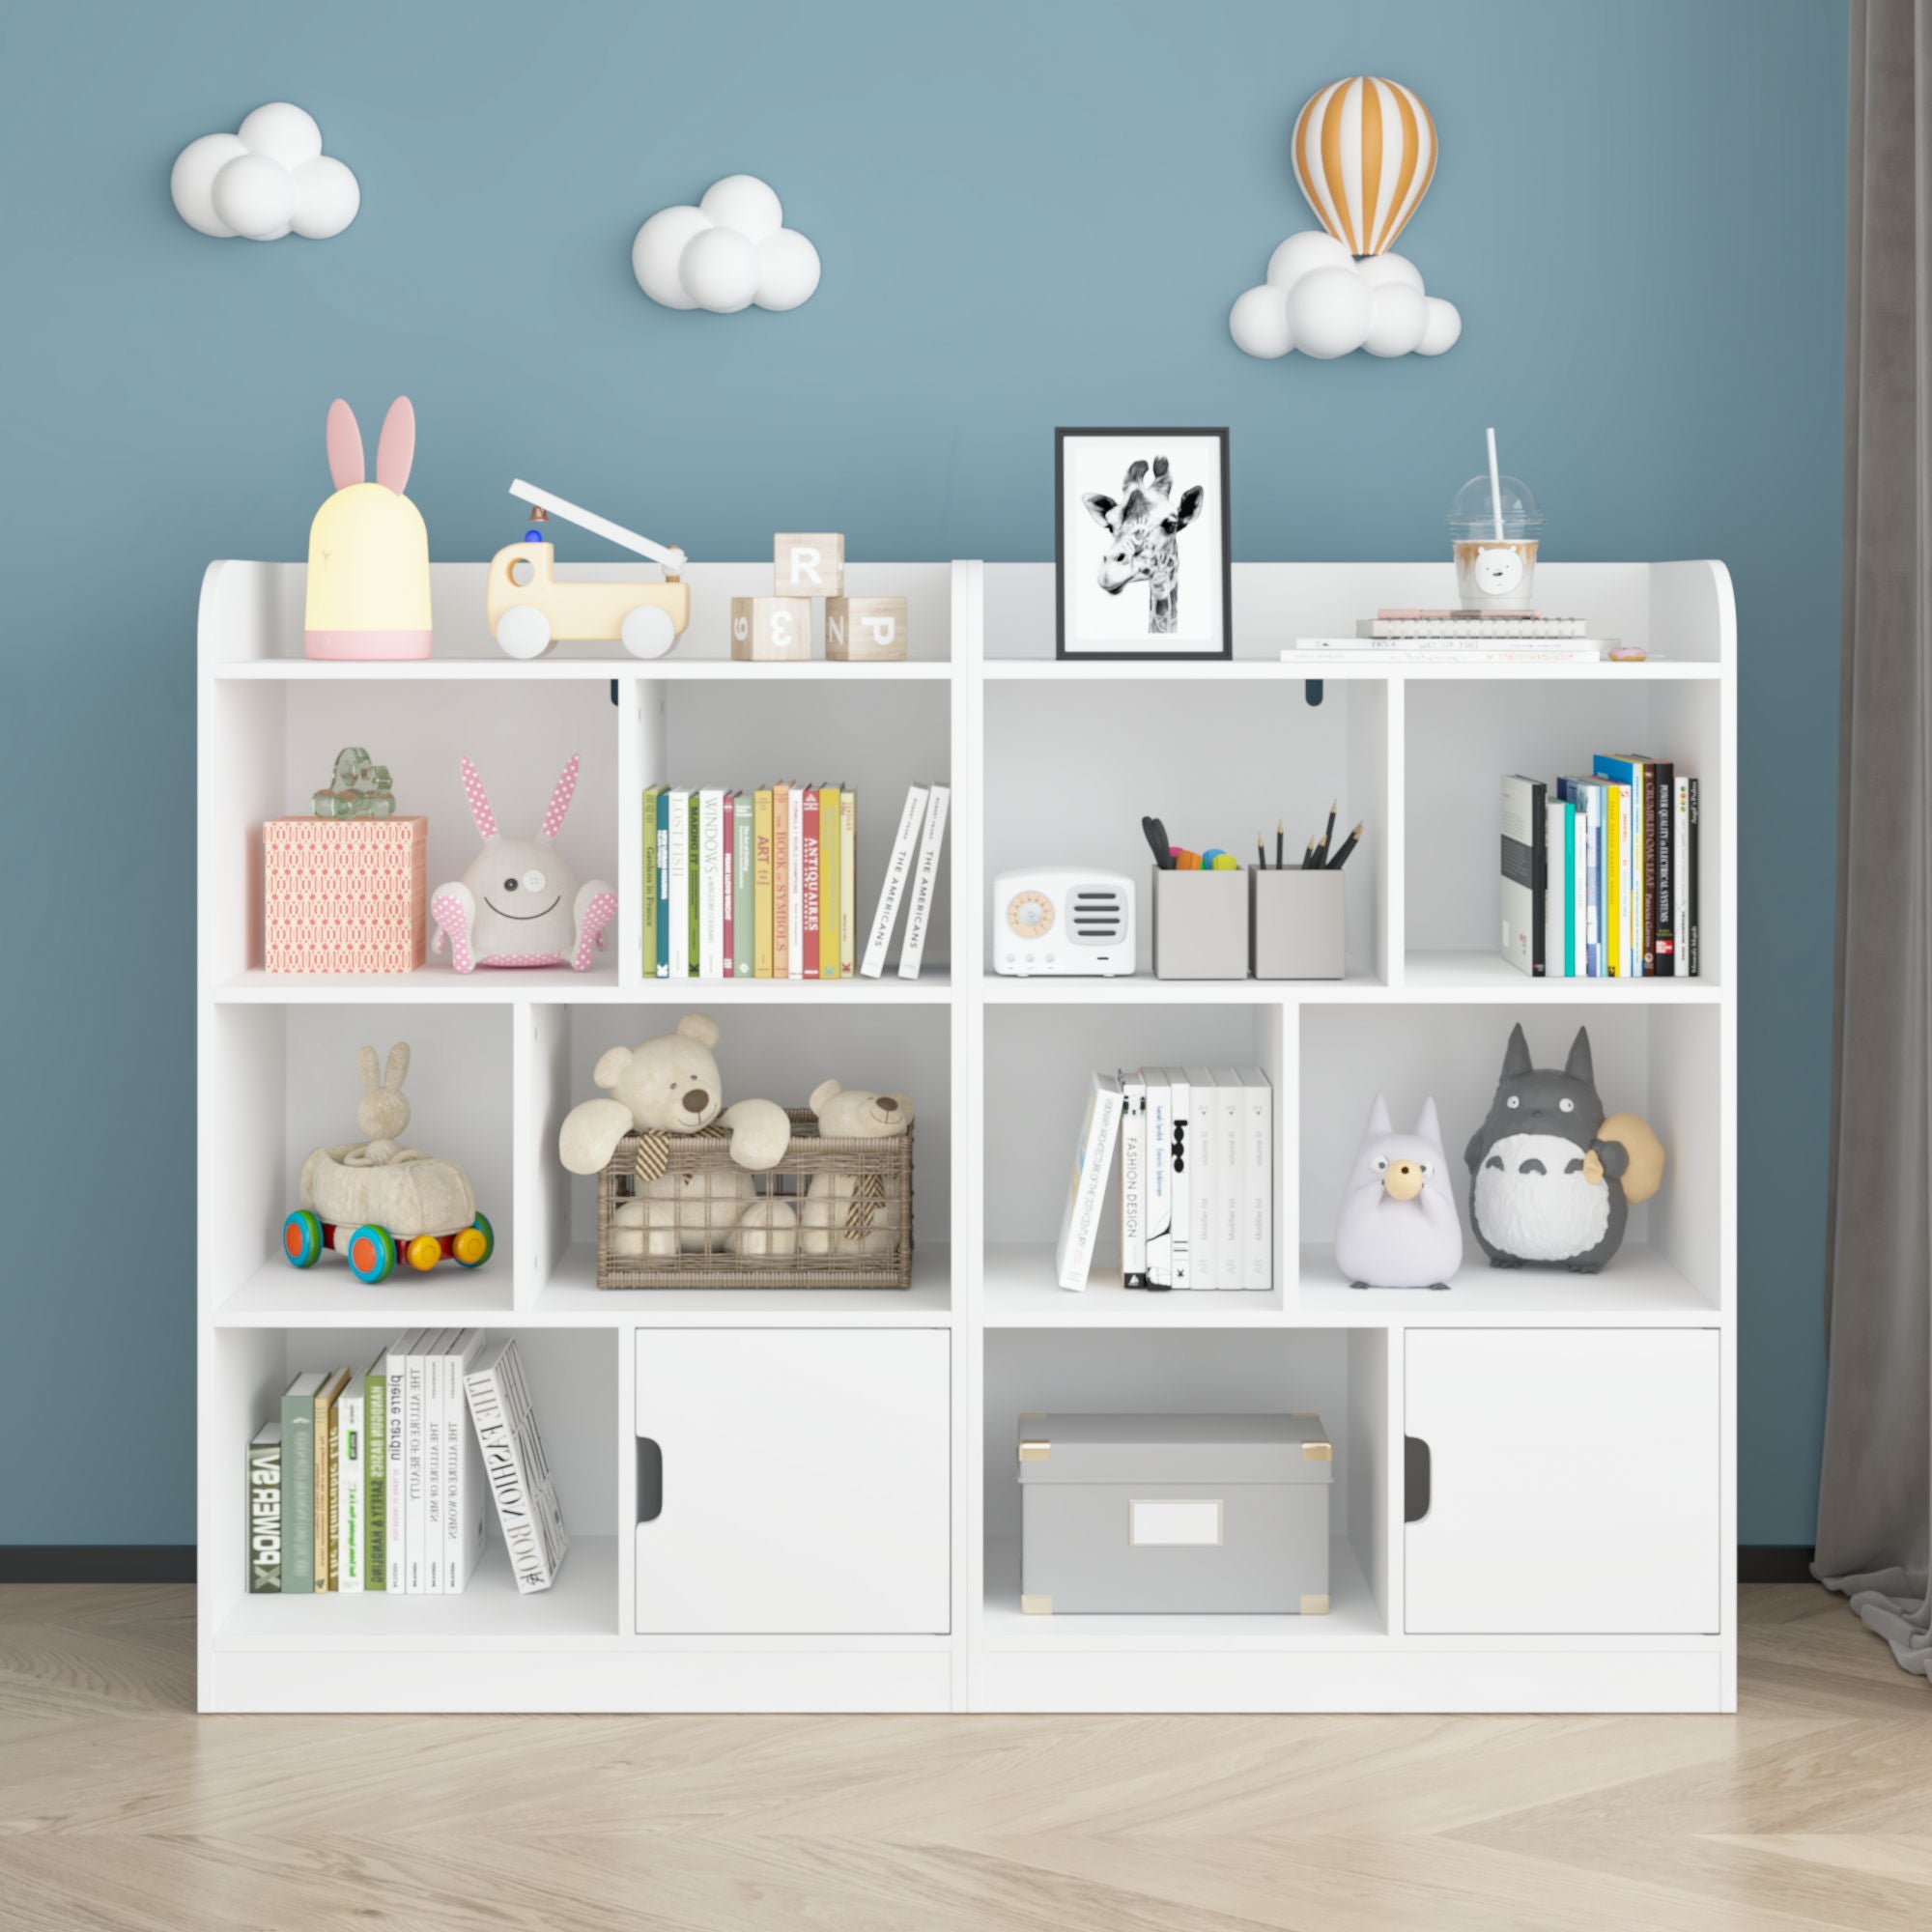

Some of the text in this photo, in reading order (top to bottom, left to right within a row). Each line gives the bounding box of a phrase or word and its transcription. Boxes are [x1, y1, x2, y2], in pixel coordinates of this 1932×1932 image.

[790, 547, 822, 584] R
[861, 616, 895, 646] P
[1659, 784, 1668, 809] POWER
[672, 798, 684, 878] LOST FISH
[690, 806, 698, 851] MAKING
[704, 797, 719, 873] WINDOWS
[1659, 808, 1668, 840] QUALITY
[690, 853, 698, 866] IT
[757, 835, 769, 865] ART
[776, 831, 787, 869] BOOK
[1645, 838, 1655, 860] OAK
[1659, 846, 1668, 891] ELECTRICAL
[645, 846, 655, 928] Gardens in France
[808, 837, 818, 931] ANTIQUAIRES
[1645, 861, 1655, 888] LEAF
[776, 884, 787, 952] SYMBOLS
[874, 851, 906, 948] THE AMERICANS
[909, 851, 933, 950] THE AMERICANS
[1659, 891, 1668, 923] SYSTEMS
[1126, 1137, 1137, 1238] FASHION DESIGN
